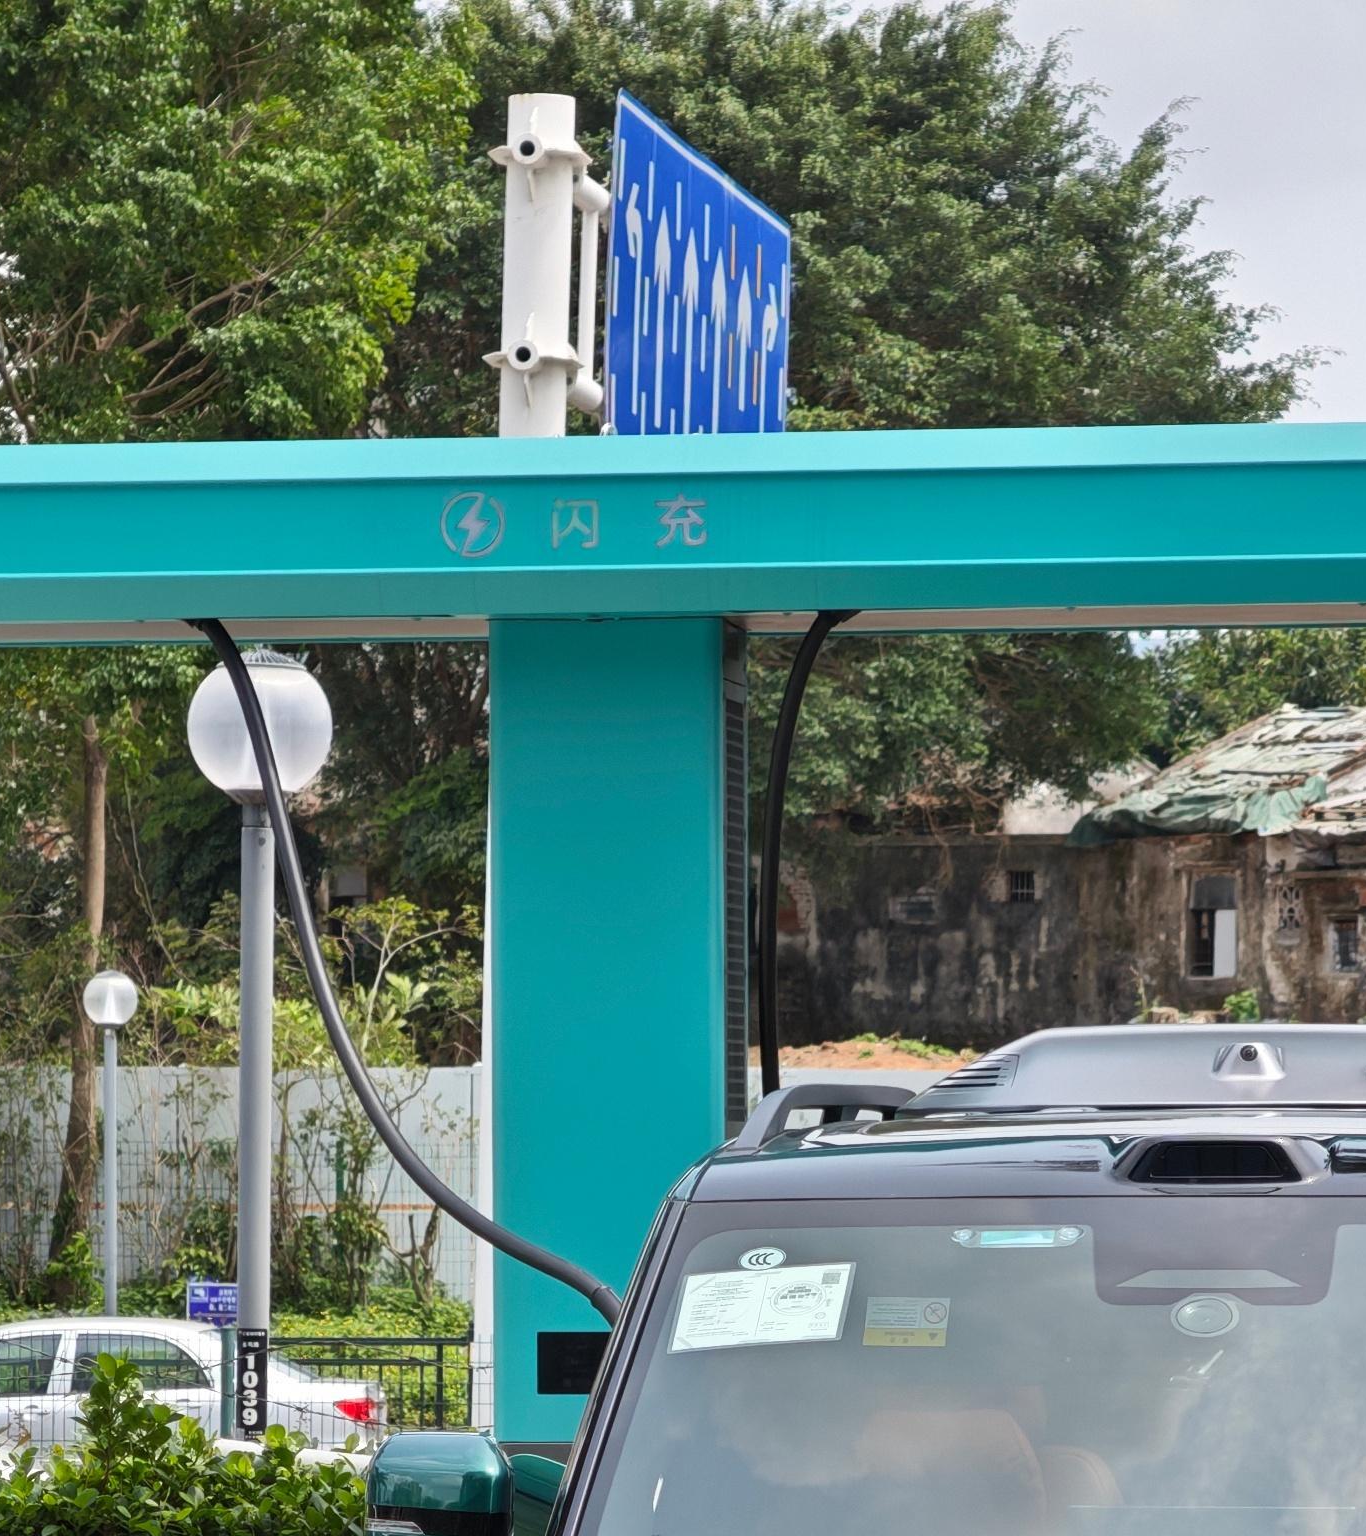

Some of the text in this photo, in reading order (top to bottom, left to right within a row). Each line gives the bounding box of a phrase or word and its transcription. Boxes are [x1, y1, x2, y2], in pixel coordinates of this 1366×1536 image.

[550, 493, 708, 550] 闪充
[748, 1252, 774, 1266] CCC
[242, 1354, 258, 1425] 1039
